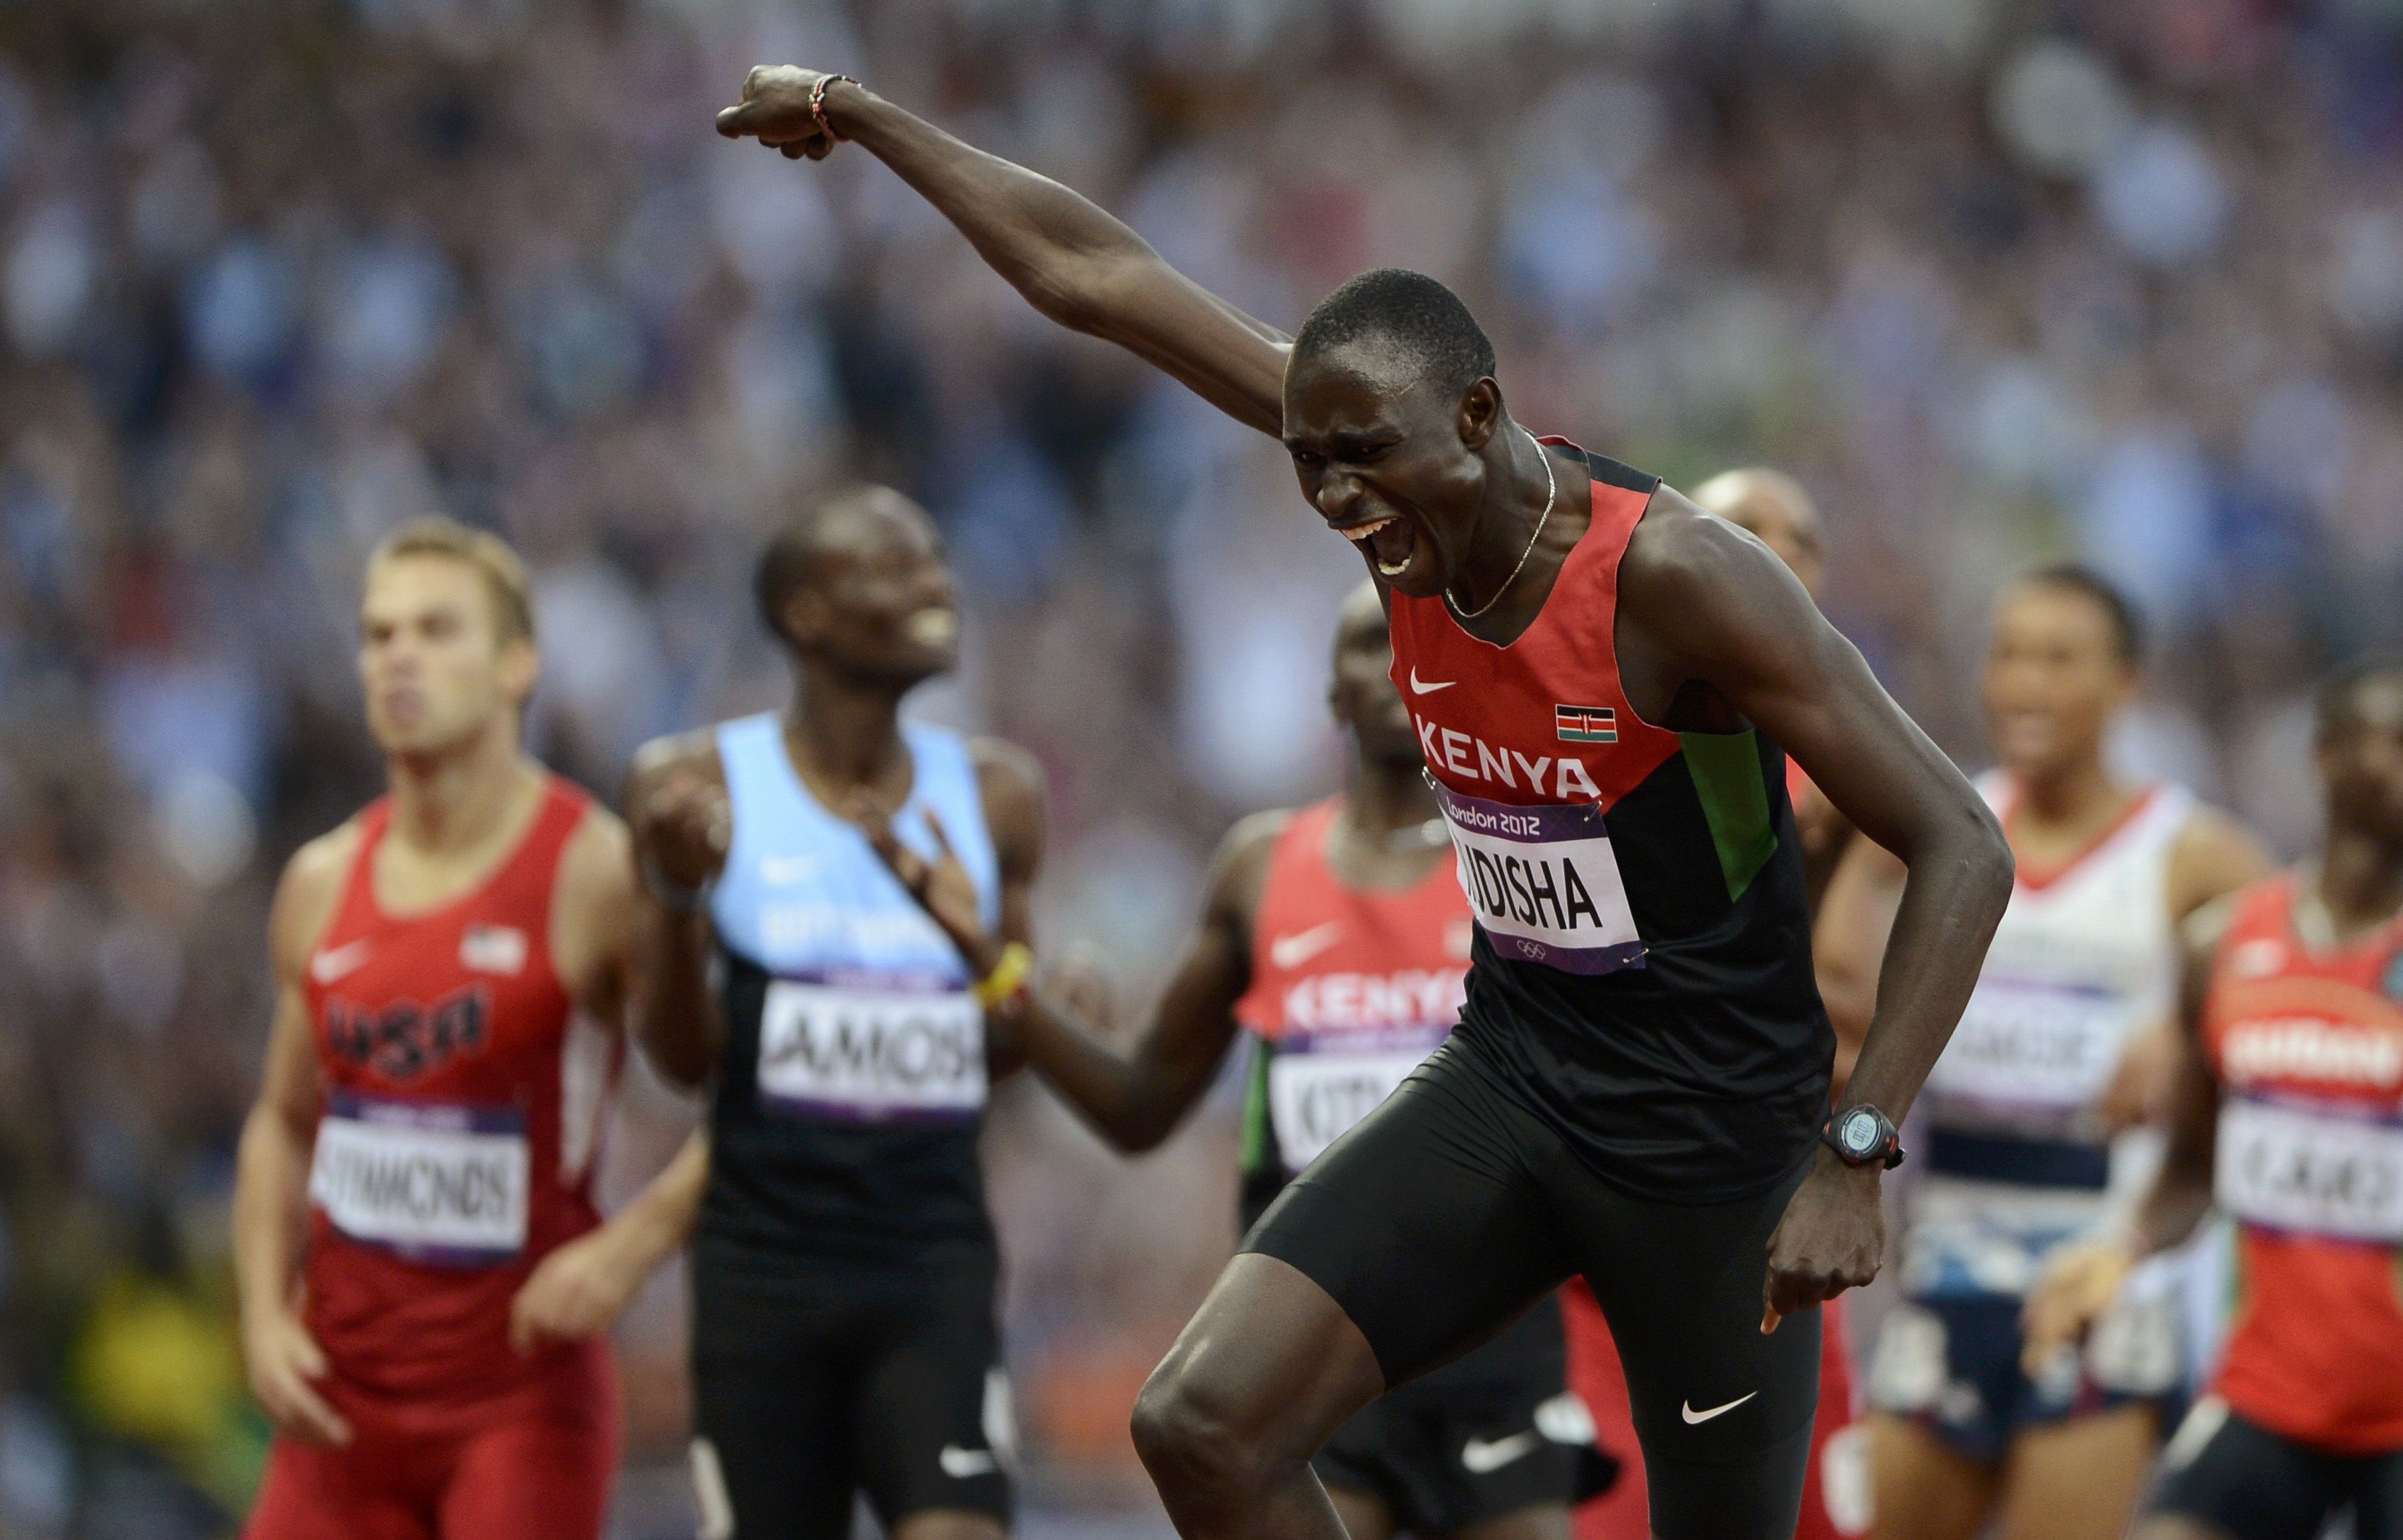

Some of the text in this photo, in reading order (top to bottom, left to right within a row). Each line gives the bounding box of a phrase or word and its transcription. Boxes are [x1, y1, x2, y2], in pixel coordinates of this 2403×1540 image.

[1414, 712, 1602, 800] KENYA
[1445, 796, 1541, 836] London 2012
[1464, 843, 1604, 931] UDISHA
[326, 988, 488, 1083] USA
